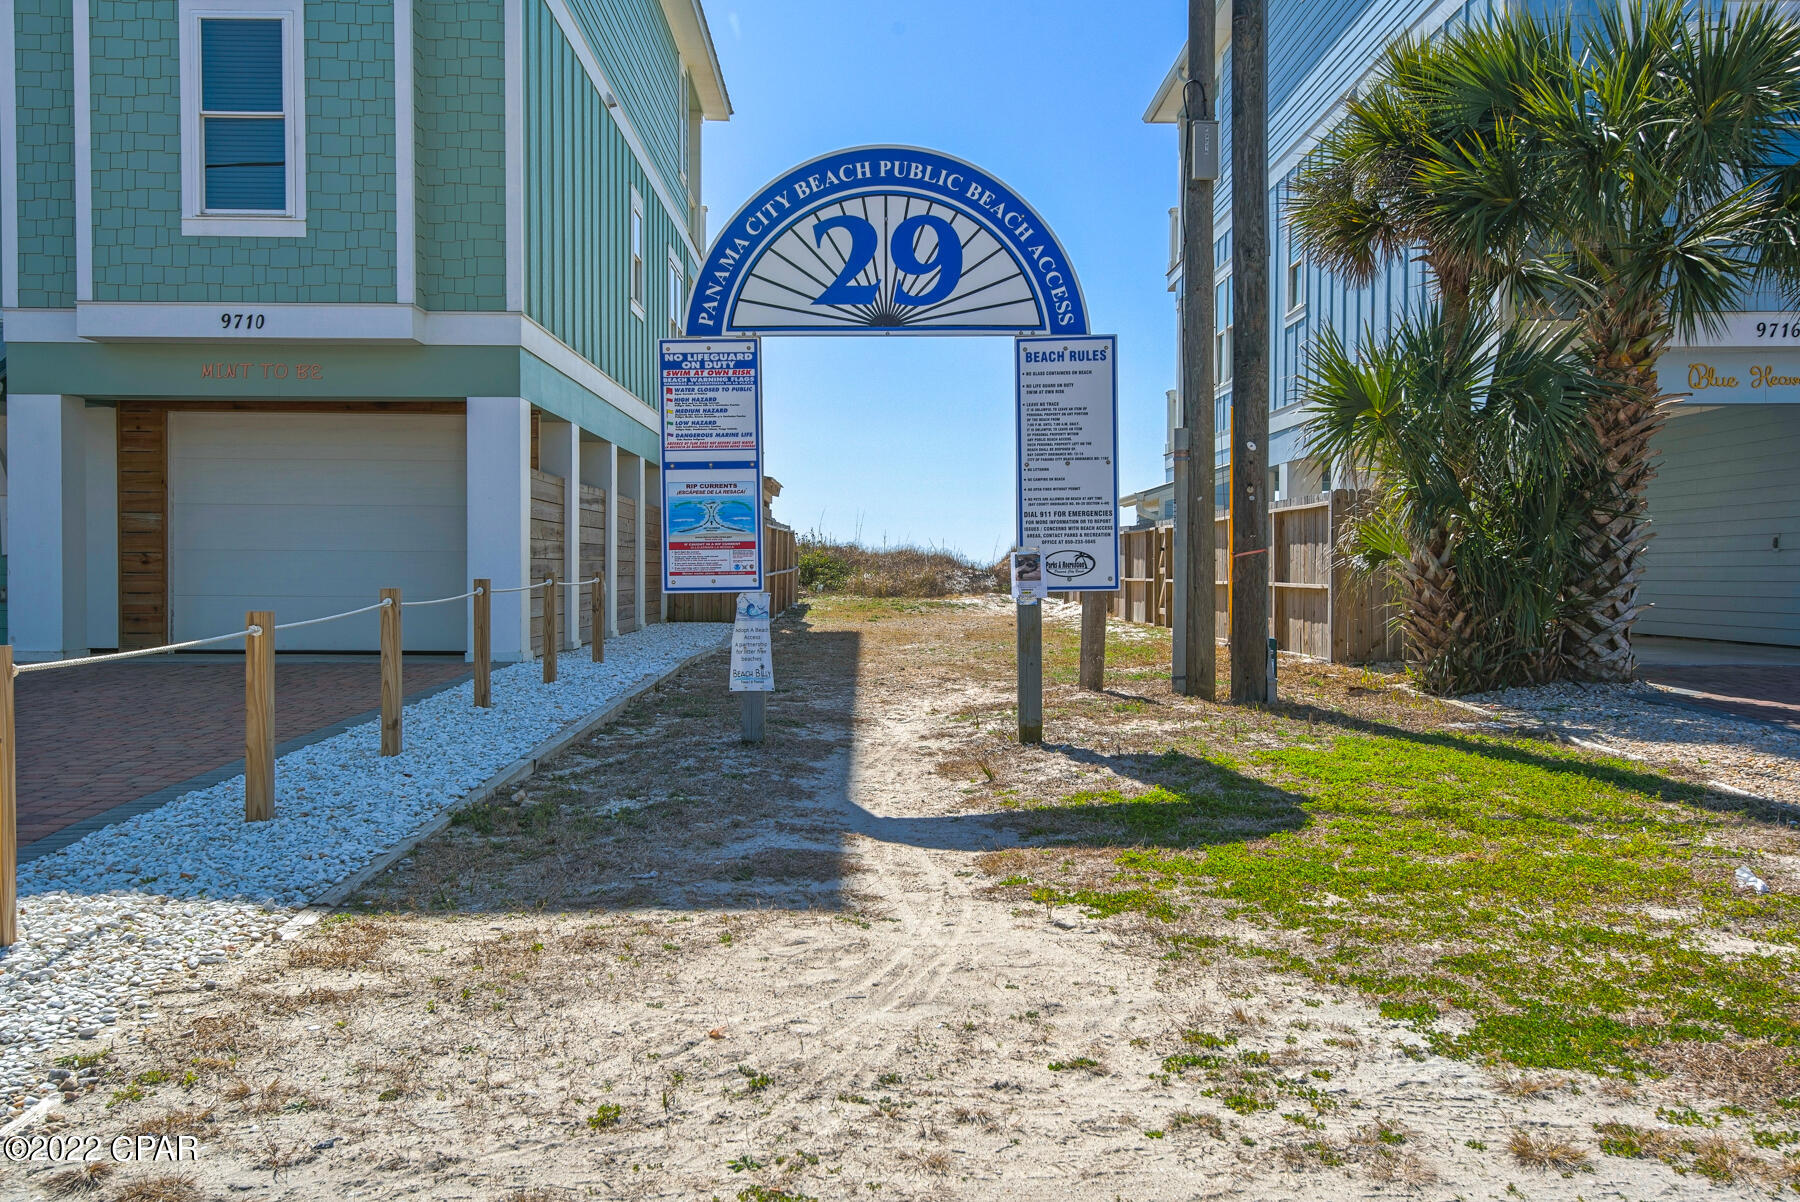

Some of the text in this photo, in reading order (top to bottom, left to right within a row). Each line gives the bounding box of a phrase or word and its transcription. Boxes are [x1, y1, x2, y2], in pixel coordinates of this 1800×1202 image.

[699, 159, 1075, 326] PANAMA CITY BEACH PUBLIC BEACH ACCESS
[810, 214, 963, 306] 29
[221, 313, 264, 329] 9710
[1757, 322, 1800, 338] 9716
[688, 353, 752, 361] LIFEGUARD
[1026, 350, 1106, 363] BEACH RULES
[201, 362, 323, 379] MINT TO BE
[1688, 363, 1739, 389] Blue
